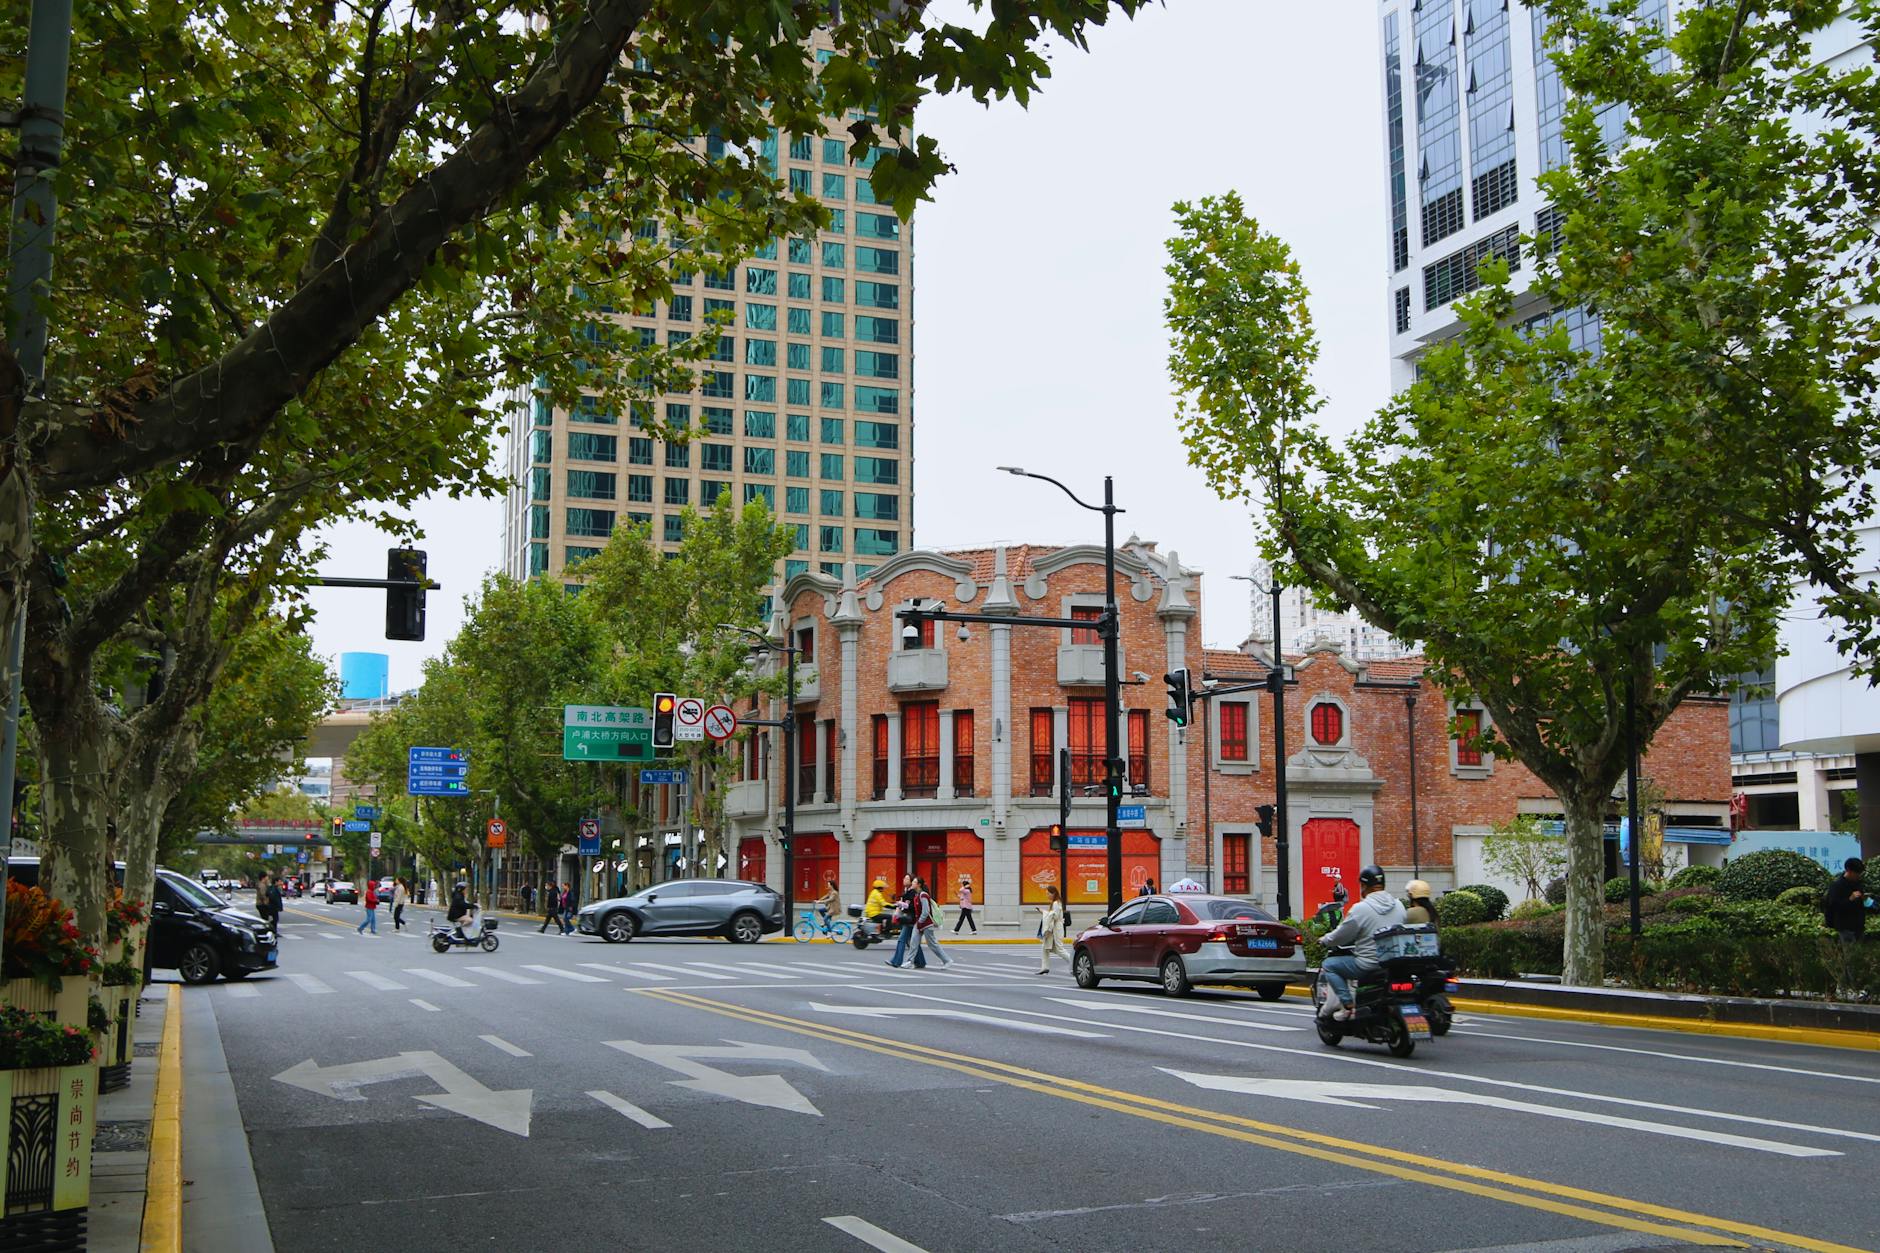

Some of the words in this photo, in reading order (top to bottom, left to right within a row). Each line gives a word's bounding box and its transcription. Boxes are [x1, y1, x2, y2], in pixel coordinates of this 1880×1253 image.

[576, 711, 645, 724] 南北高架路
[571, 731, 649, 741] 卢浦大桥方向入口
[1320, 866, 1341, 874] 回力
[66, 1079, 83, 1177] 崇尚节约
